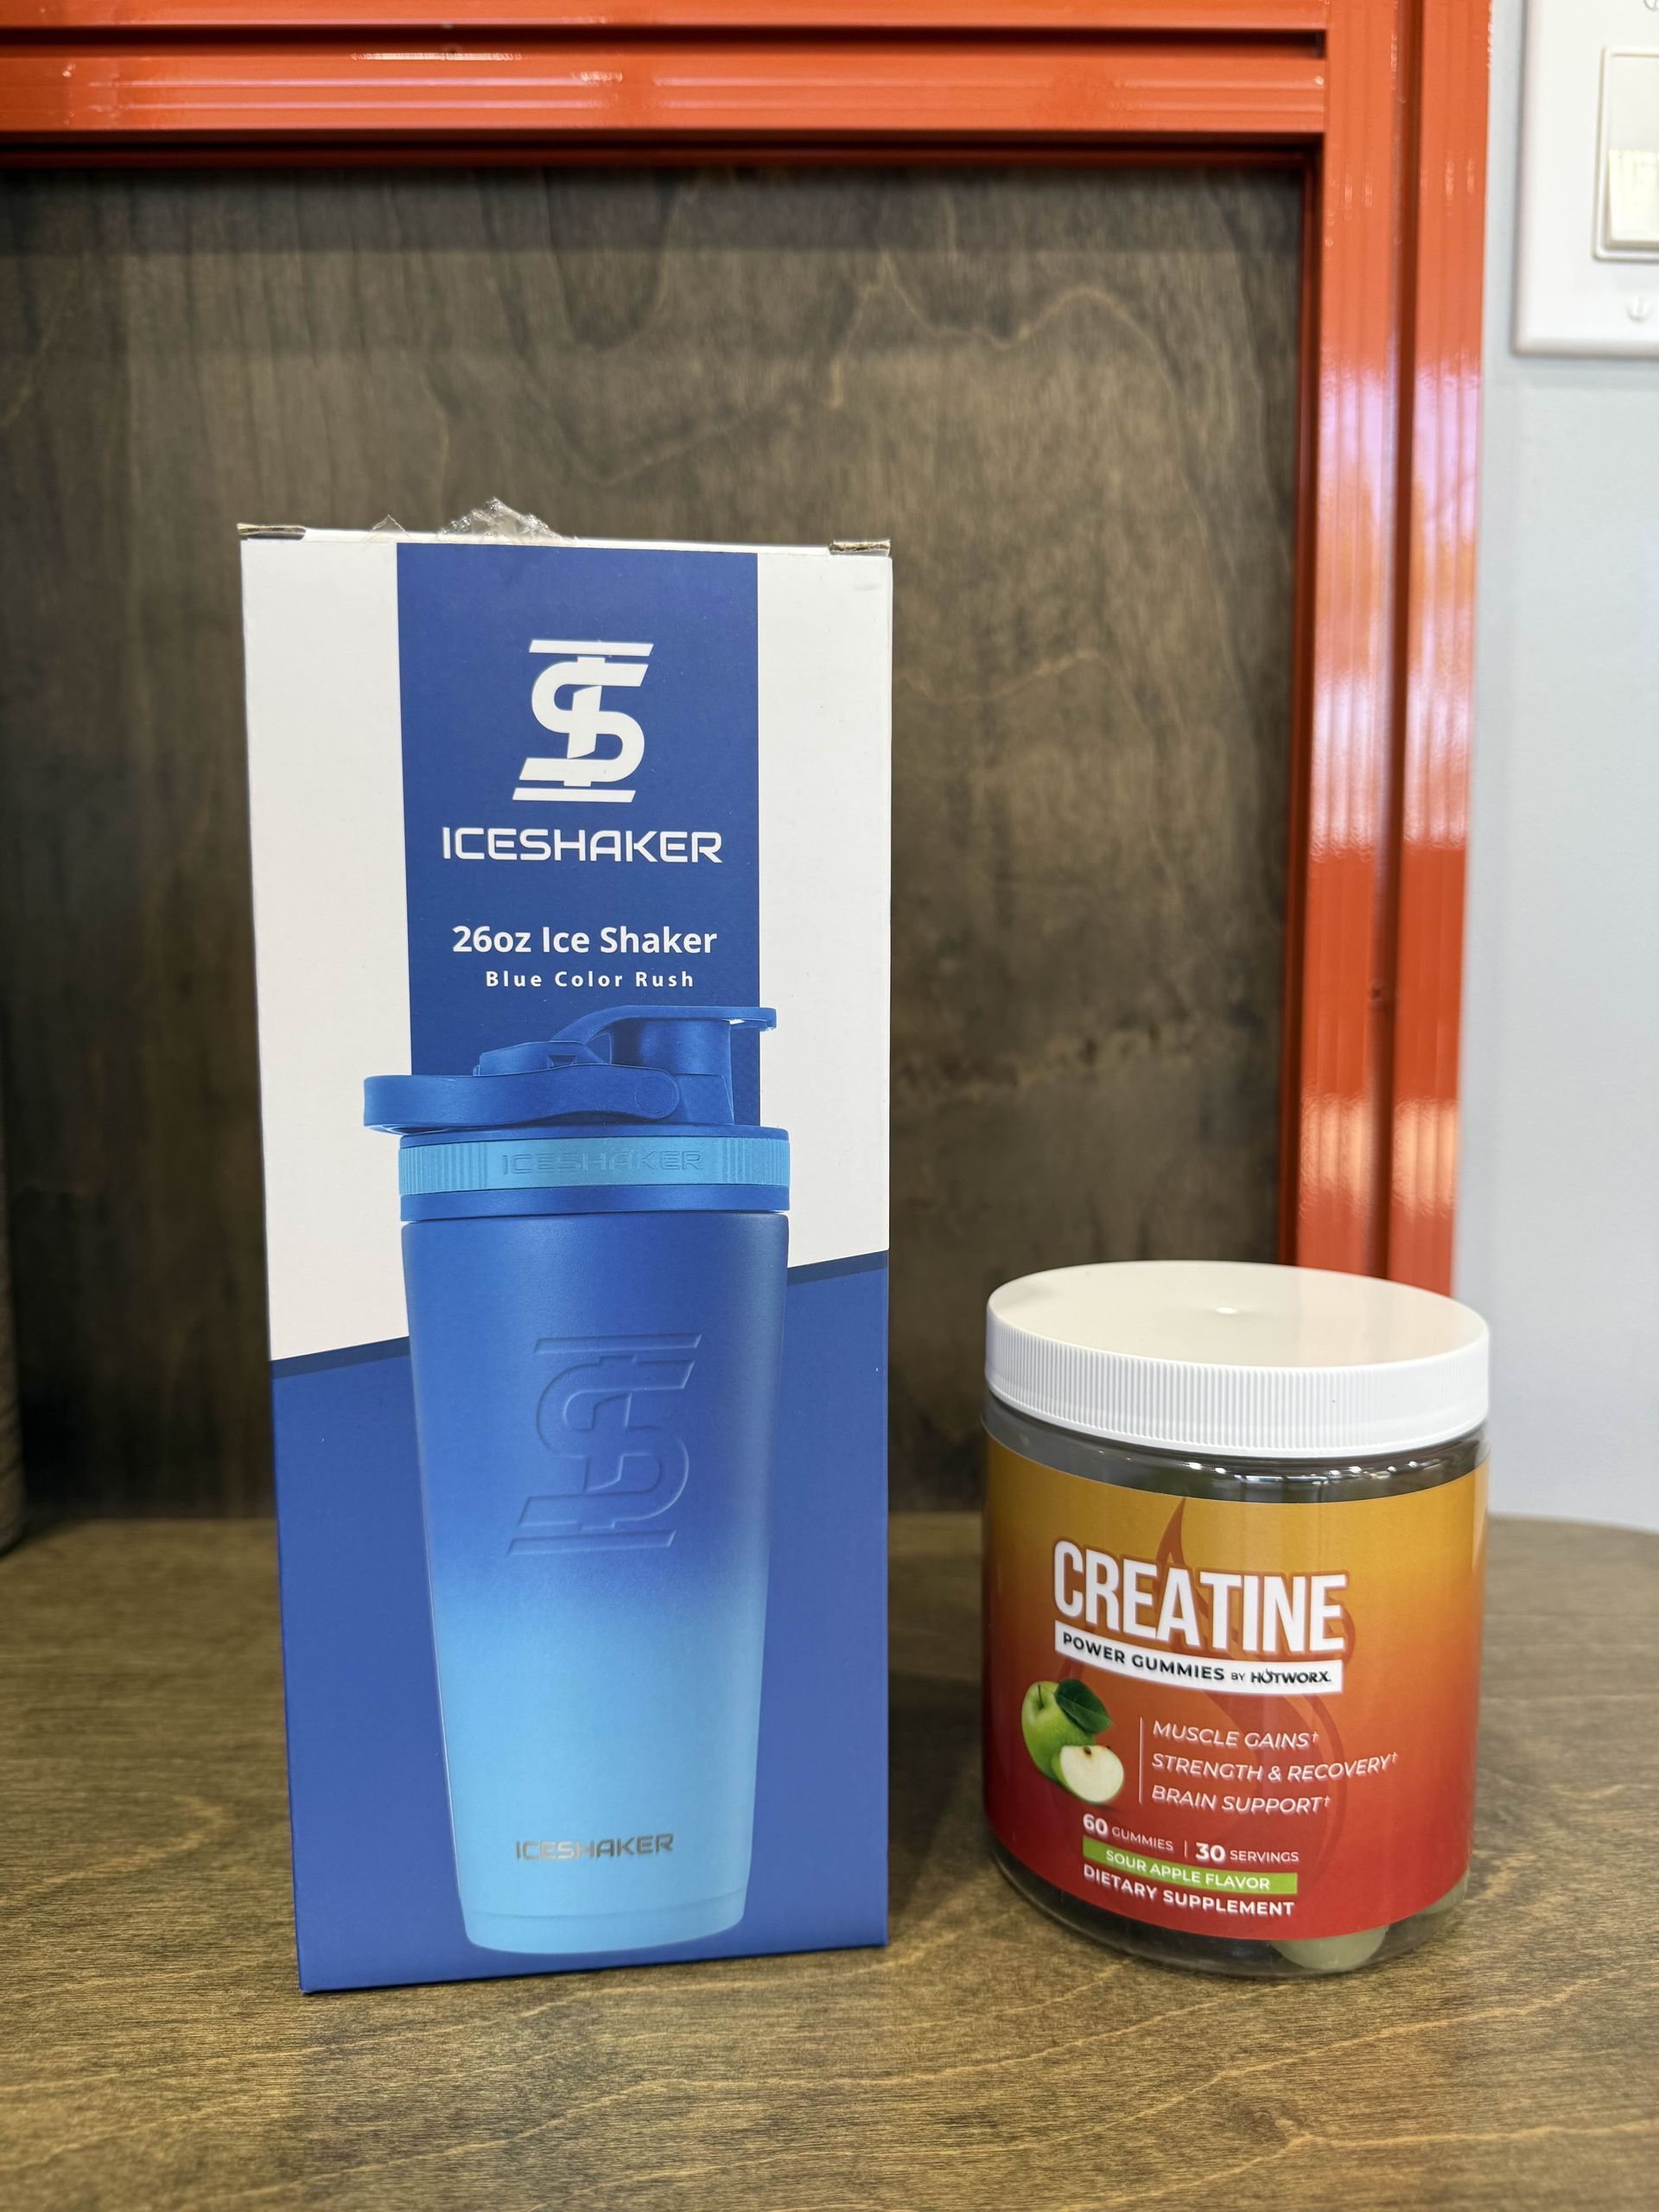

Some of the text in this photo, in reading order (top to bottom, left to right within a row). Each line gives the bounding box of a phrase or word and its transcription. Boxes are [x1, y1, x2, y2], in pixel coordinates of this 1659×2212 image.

[442, 826, 723, 863] ICESHAKER
[452, 925, 717, 954] 26oz Ice Shaker
[486, 971, 694, 988] Blue Color Rush
[501, 1150, 704, 1174] ICESHAKER
[1053, 1540, 1348, 1652] CREATINE
[1062, 1630, 1127, 1665] POWER
[1131, 1654, 1225, 1681] GUMMIES
[1230, 1672, 1246, 1682] BY
[1153, 1720, 1238, 1749] MUSCLE
[1152, 1753, 1262, 1781] STRENGTH
[1268, 1766, 1282, 1782] &
[1152, 1785, 1217, 1812] BRAIN
[516, 1833, 673, 1859] ICESHAKER
[1083, 1814, 1174, 1852] 60 GUMMIES
[1195, 1842, 1300, 1863] 30 SERVINGS
[1105, 1848, 1270, 1891] SOUR APPLE FLAVOR
[1083, 1864, 1294, 1916] DIETARY SUPPLEMENT
